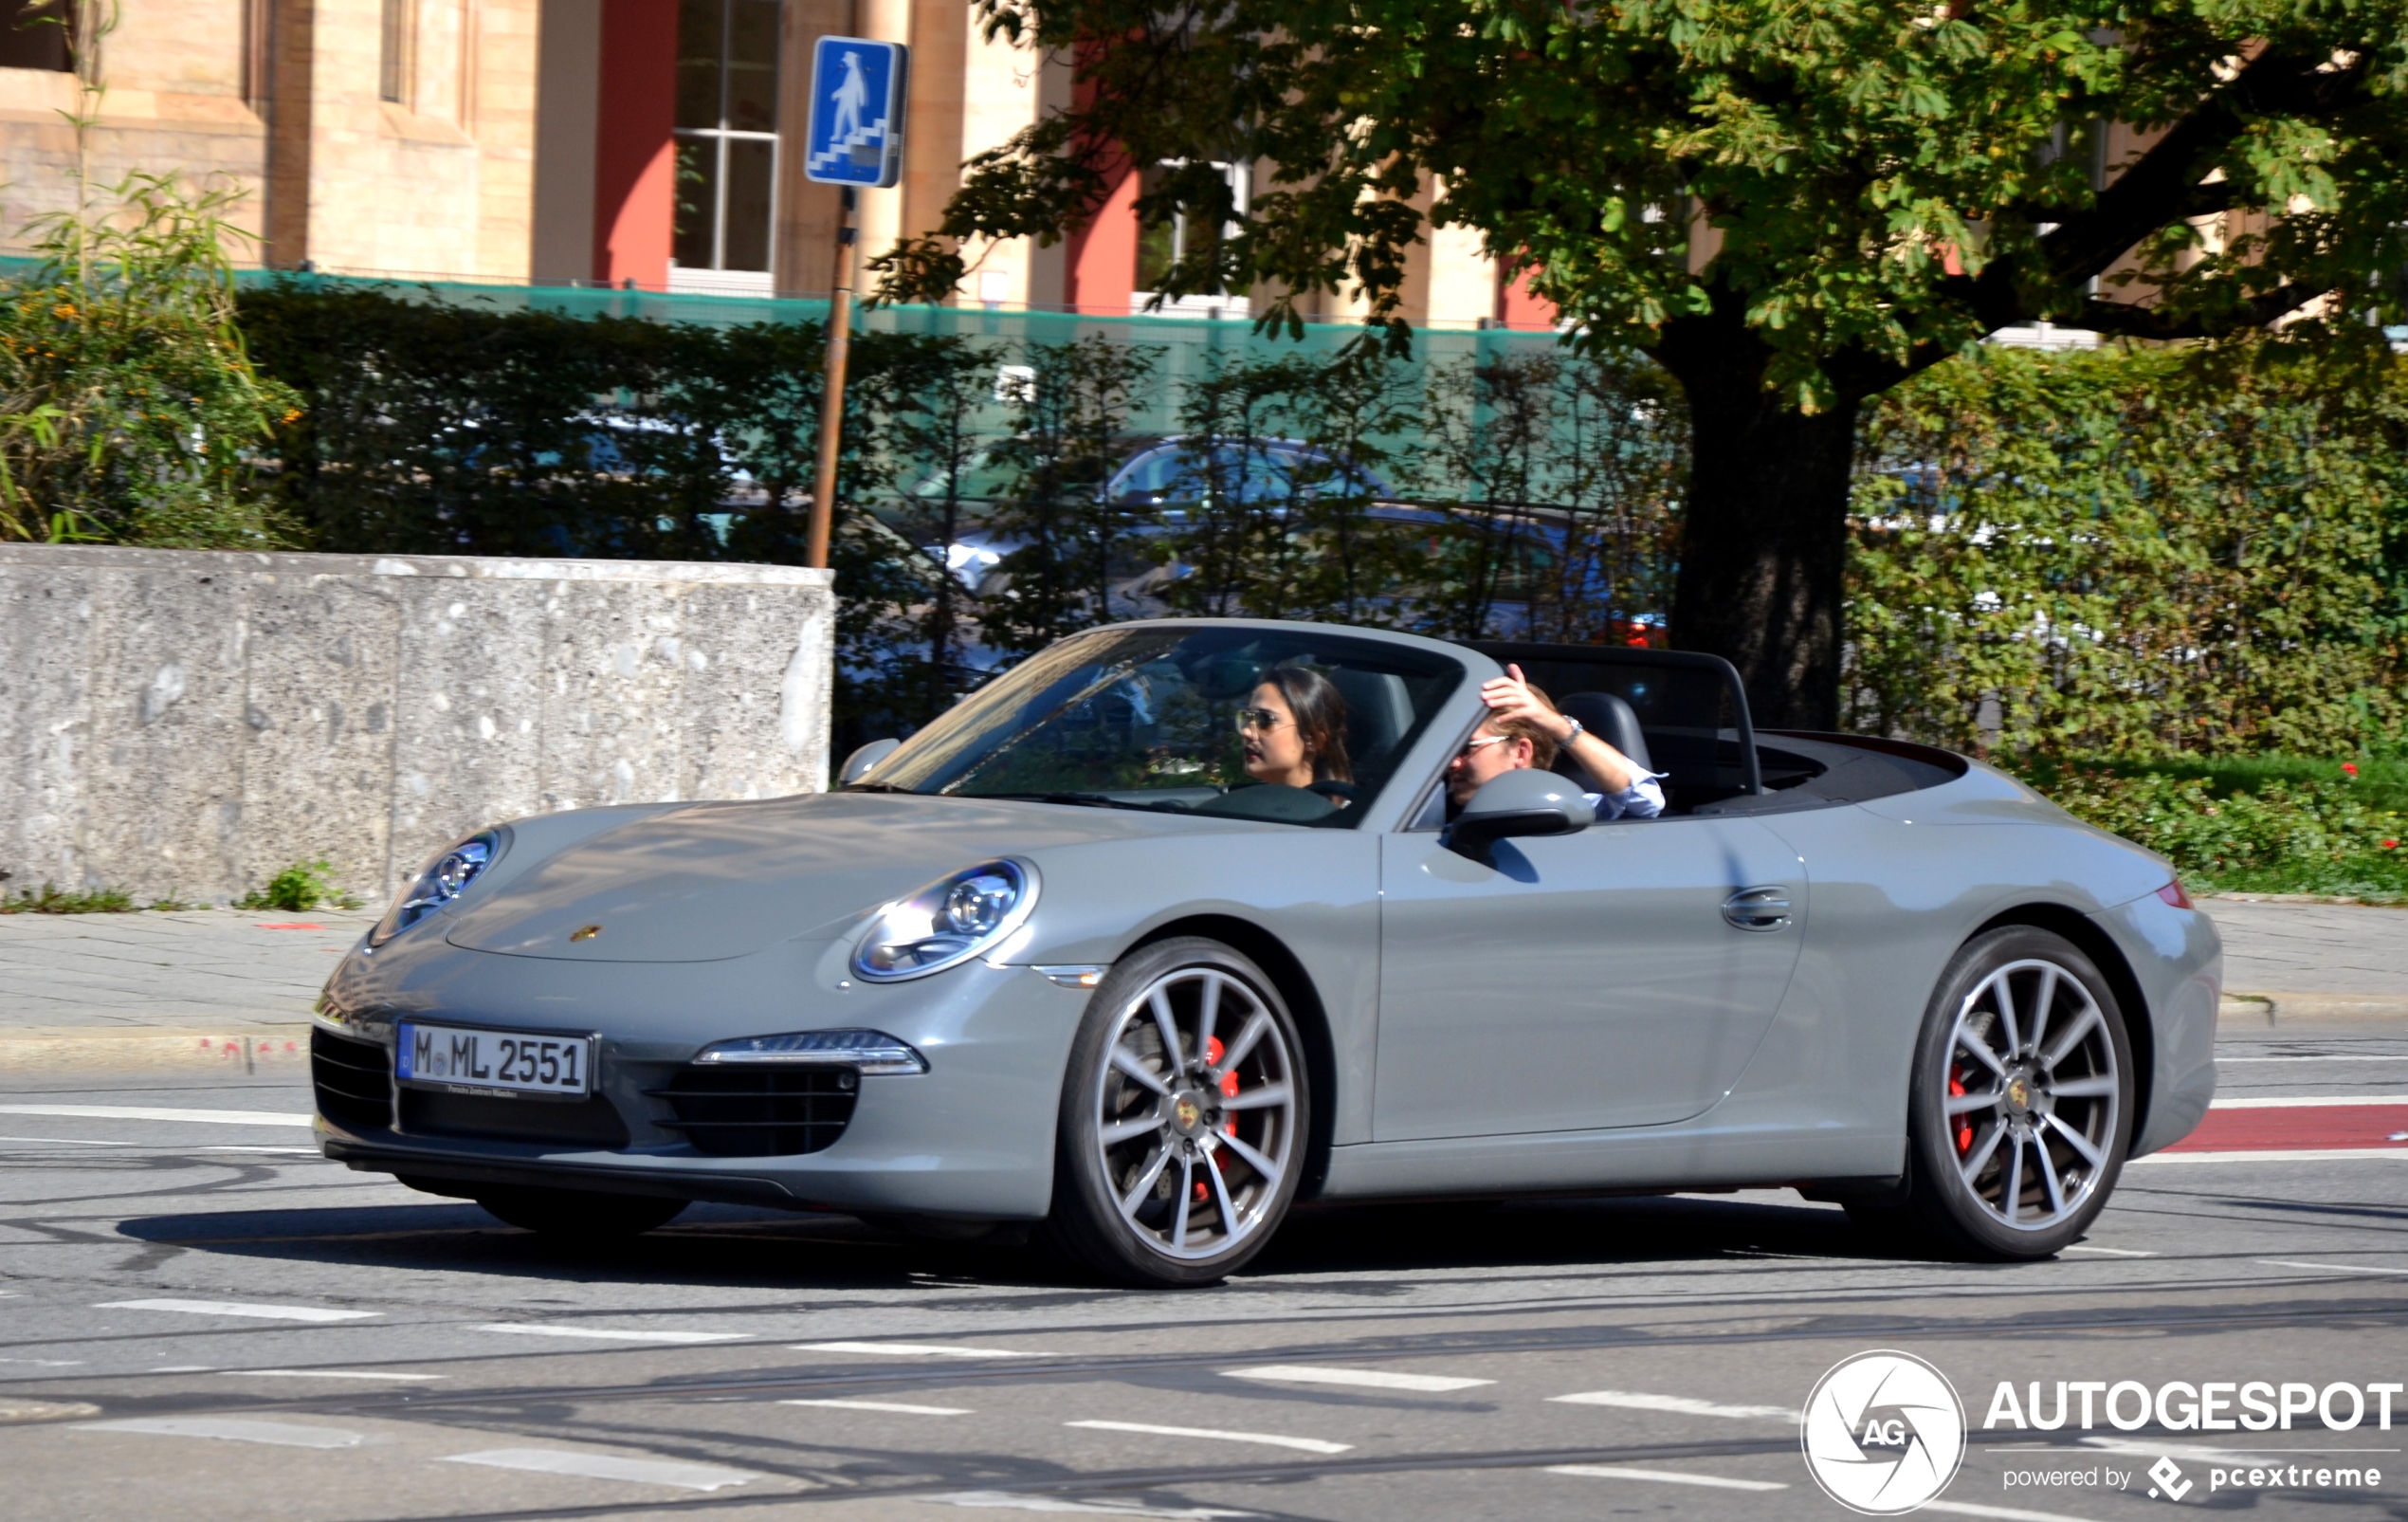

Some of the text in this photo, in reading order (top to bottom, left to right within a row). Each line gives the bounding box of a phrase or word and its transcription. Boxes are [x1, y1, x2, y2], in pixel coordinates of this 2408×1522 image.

[414, 1031, 581, 1087] M ML 2551
